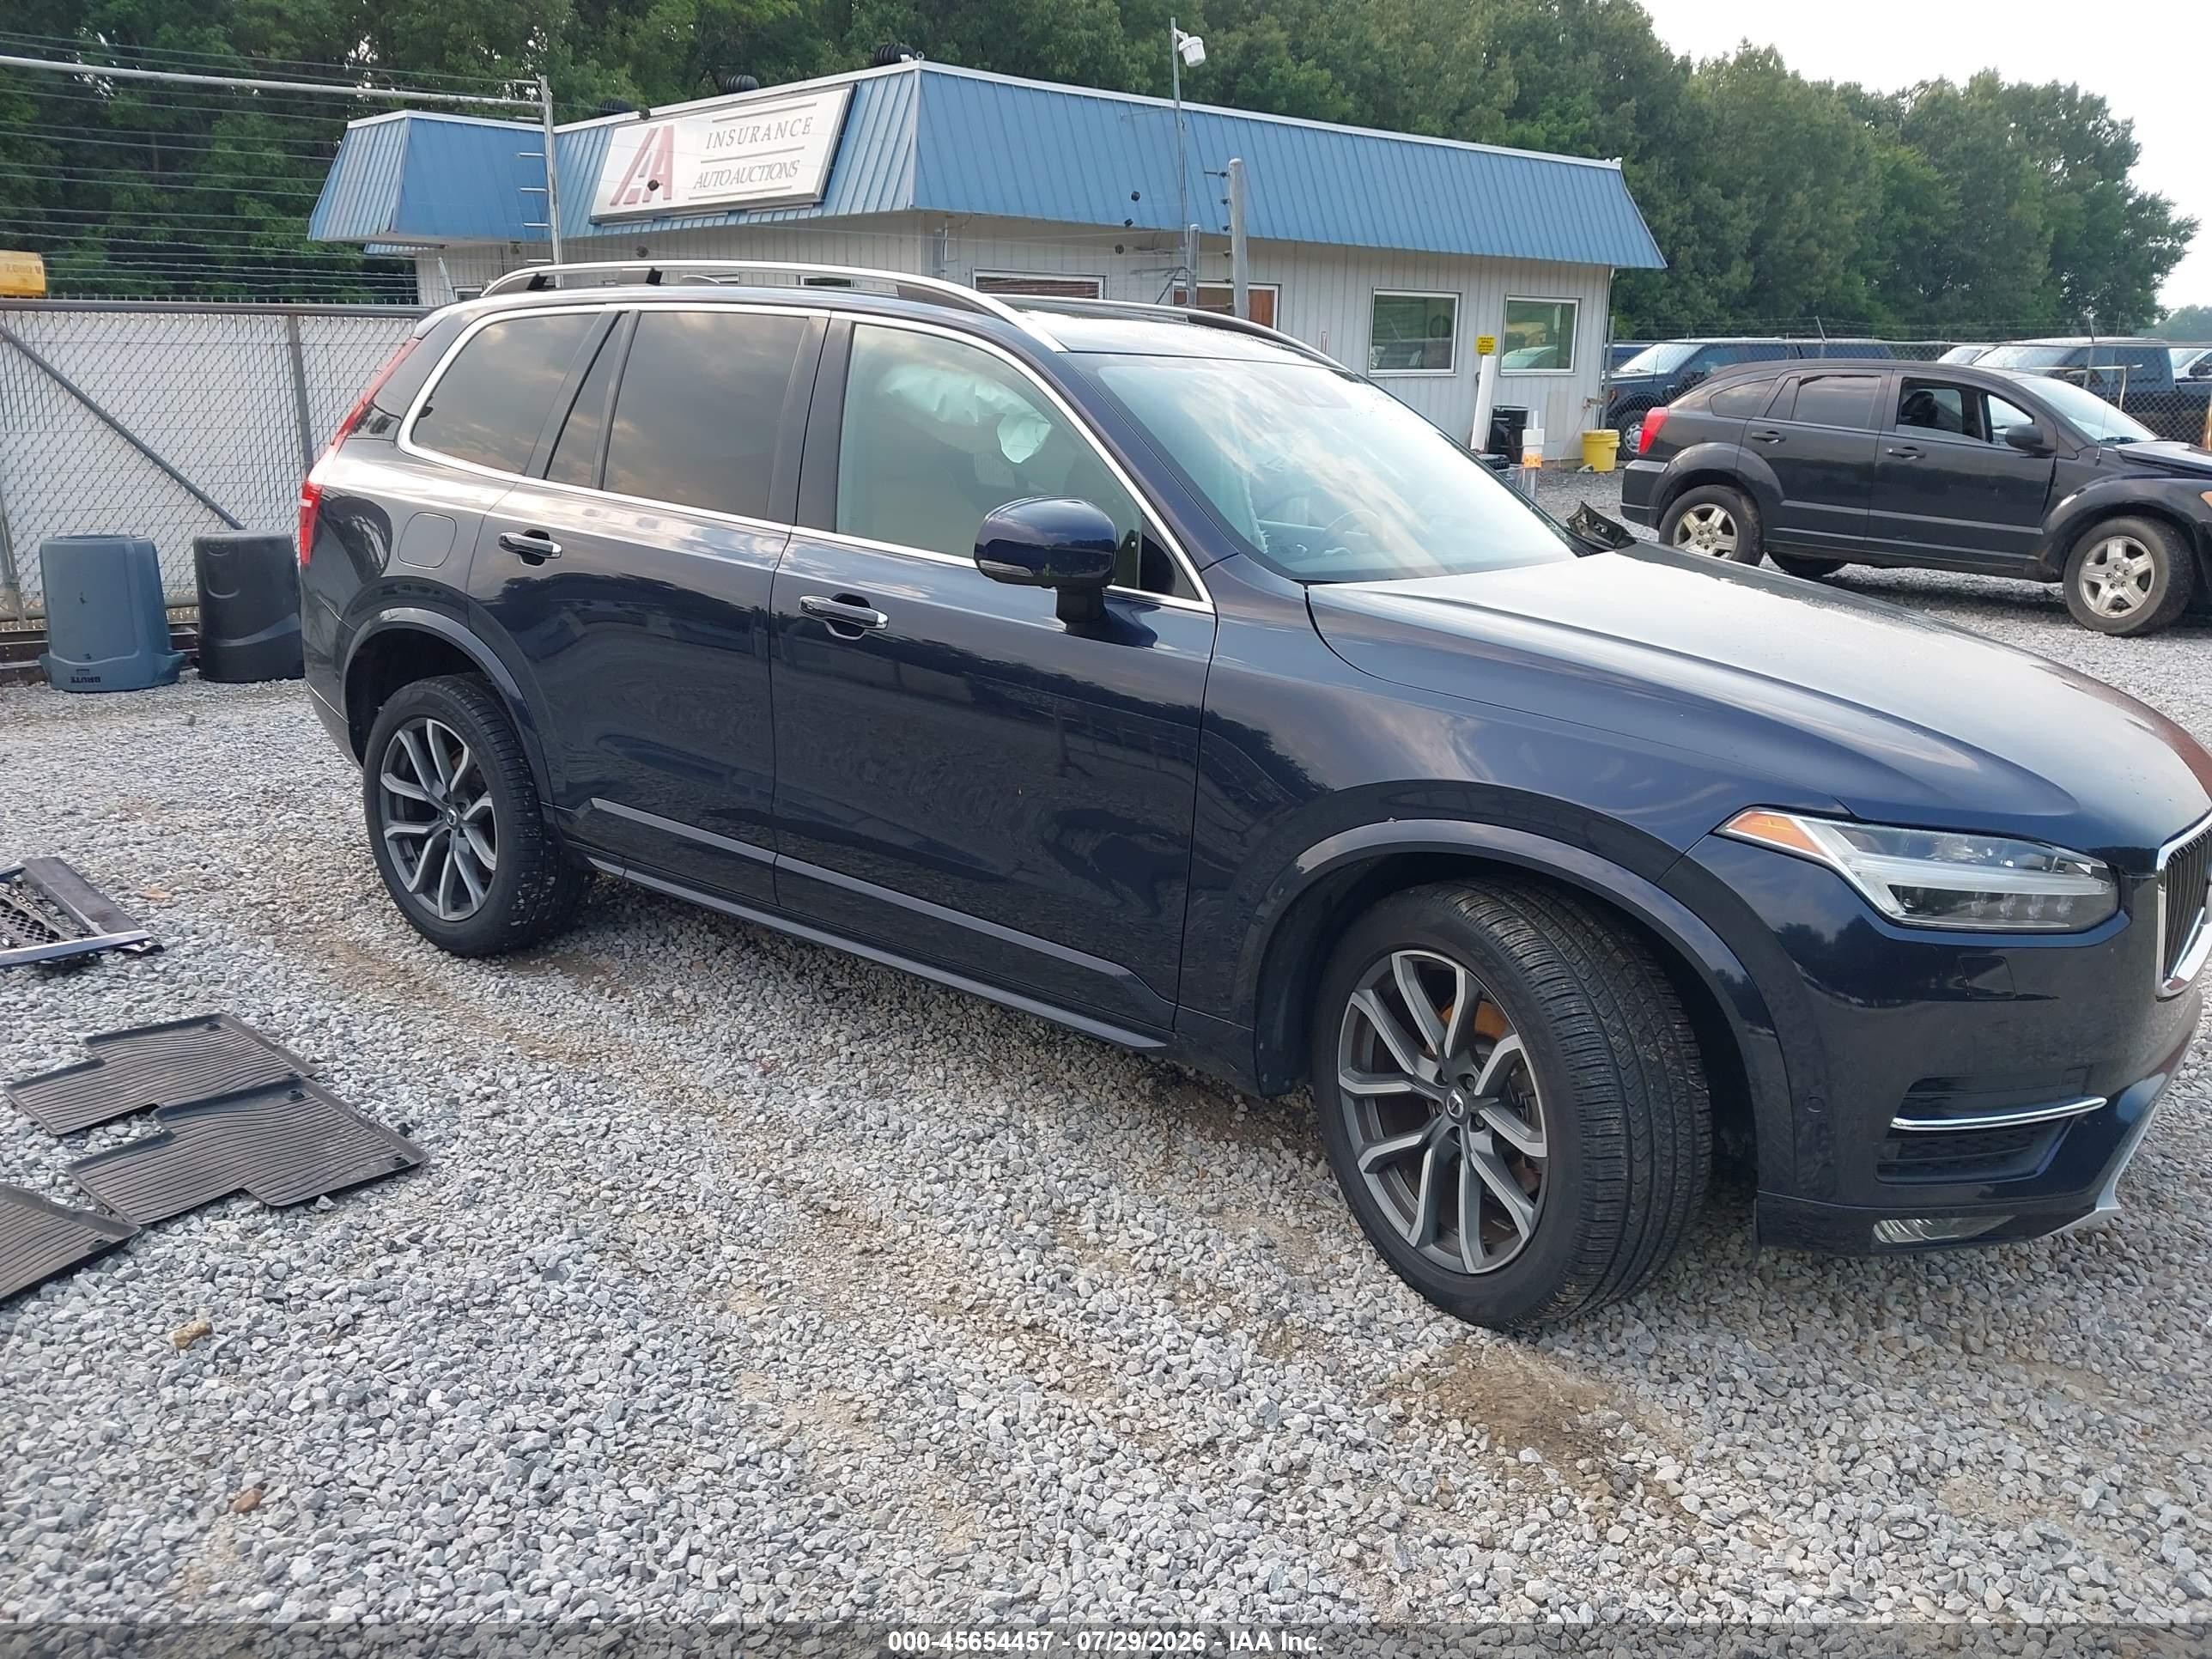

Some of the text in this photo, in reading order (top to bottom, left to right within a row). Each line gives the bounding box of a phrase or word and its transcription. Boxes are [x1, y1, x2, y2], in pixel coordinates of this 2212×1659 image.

[706, 117, 813, 149] INSURANCE
[693, 161, 799, 189] AUTO AUCTIONS
